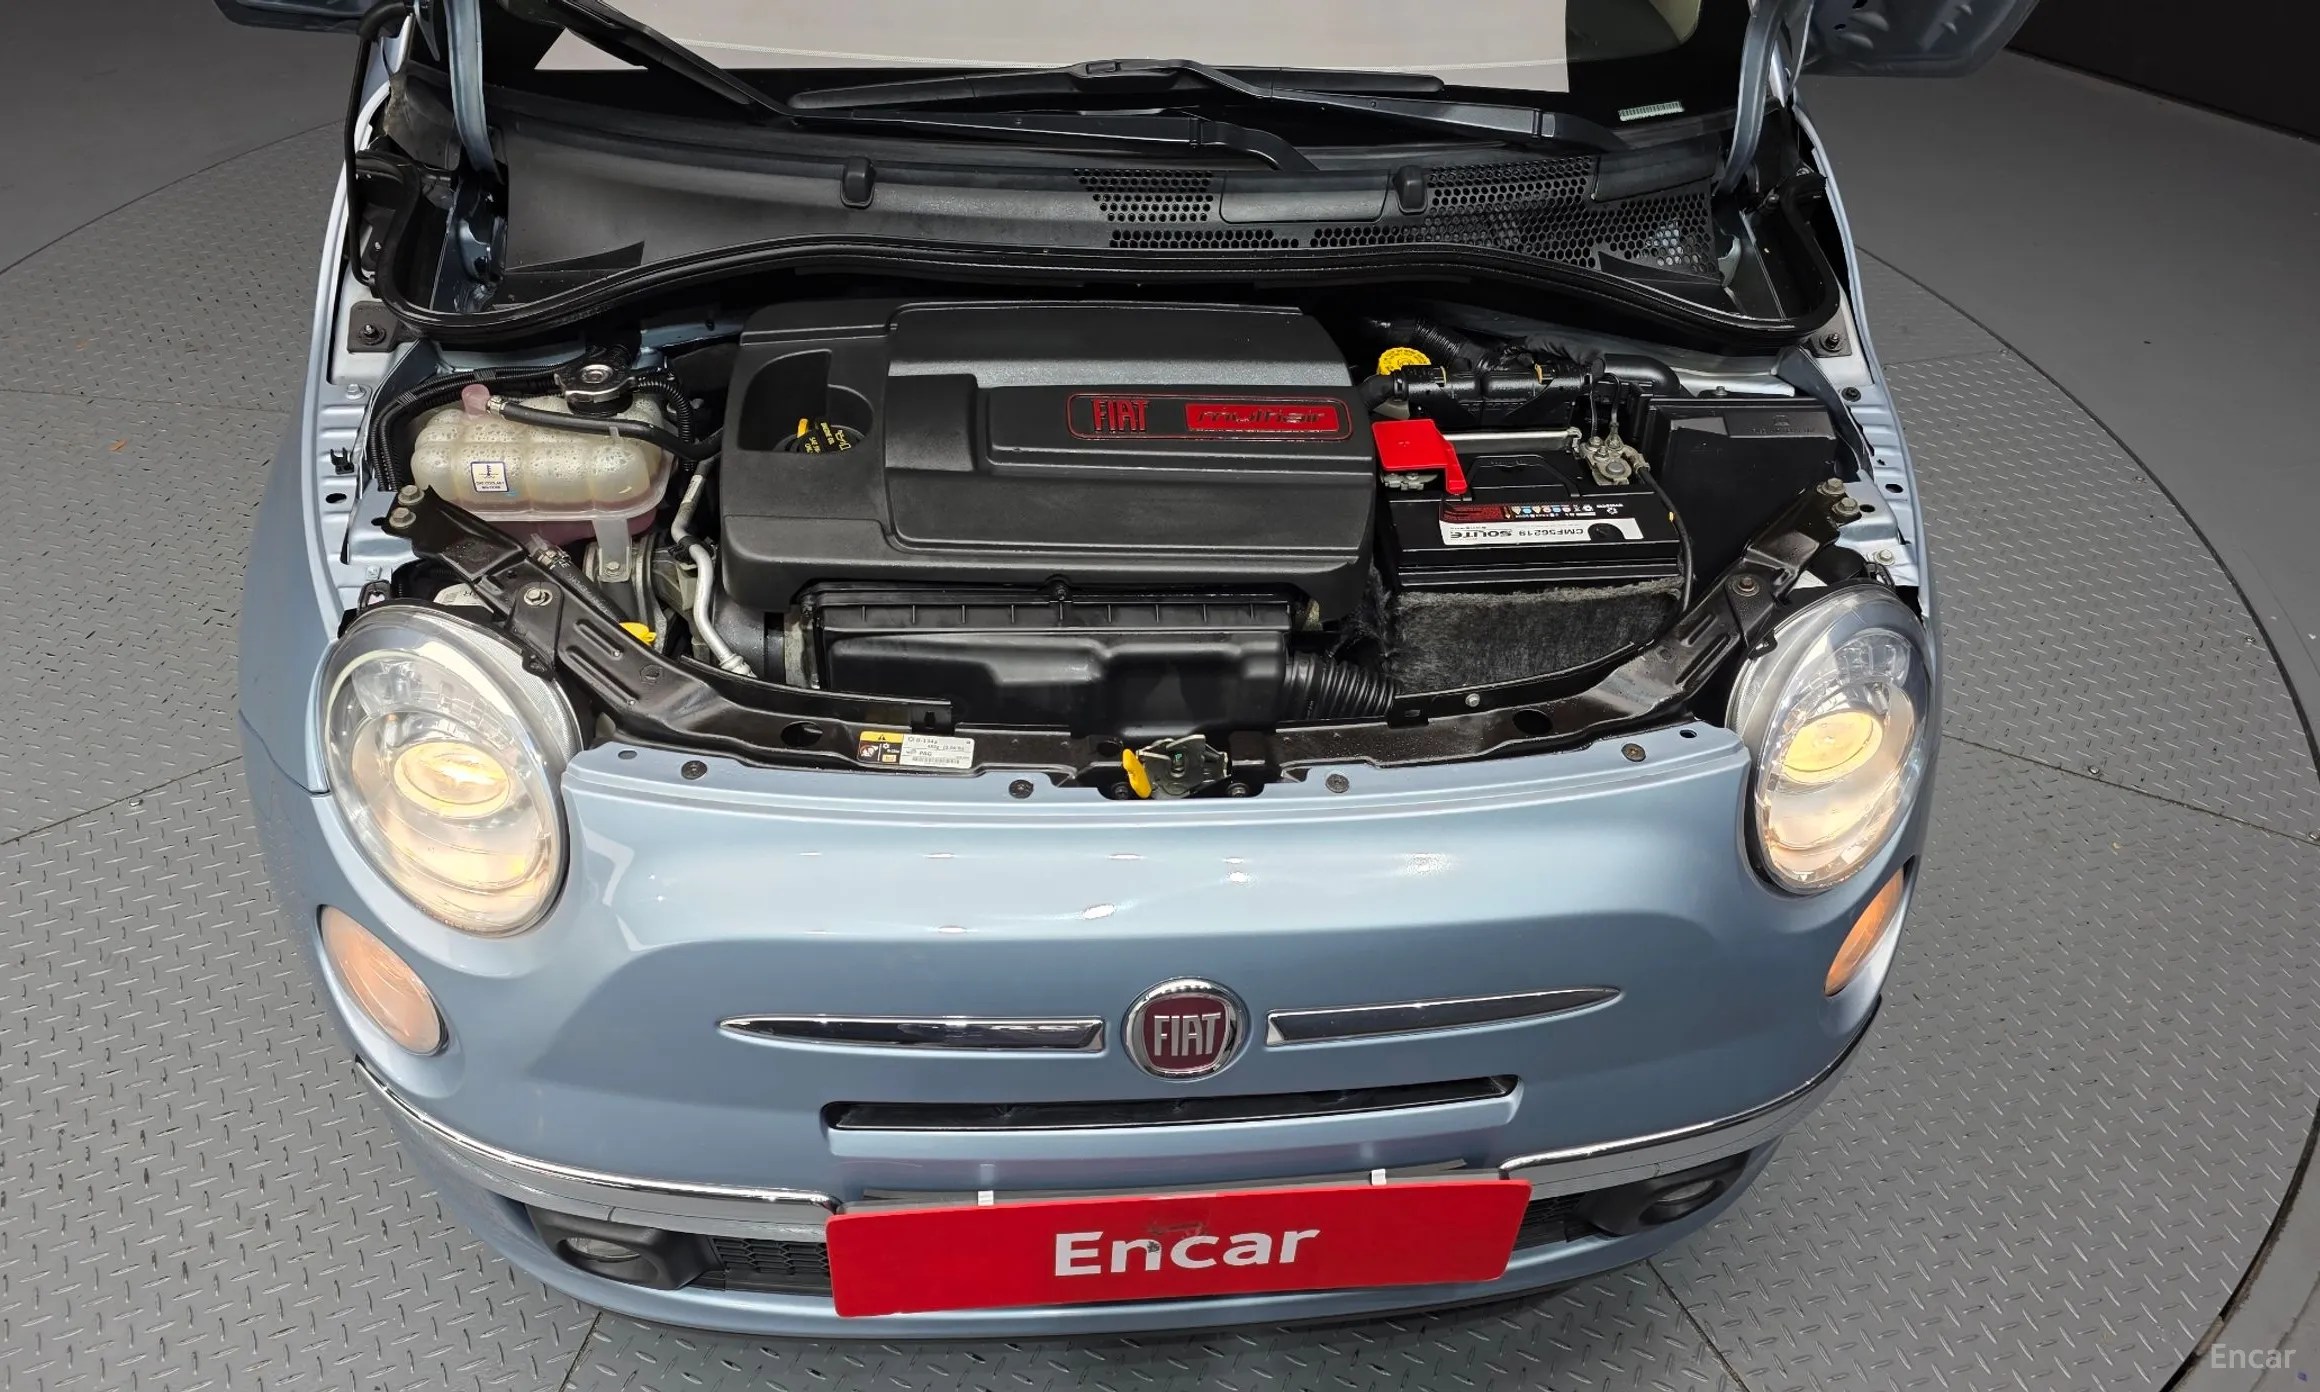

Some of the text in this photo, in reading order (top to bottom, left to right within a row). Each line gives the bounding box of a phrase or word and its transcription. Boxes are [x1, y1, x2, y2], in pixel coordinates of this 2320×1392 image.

[1092, 398, 1151, 433] FIAT
[1450, 528, 1584, 539] CMF56219 SOLITE
[1153, 1011, 1222, 1057] FIAT
[1054, 1228, 1321, 1277] Encar
